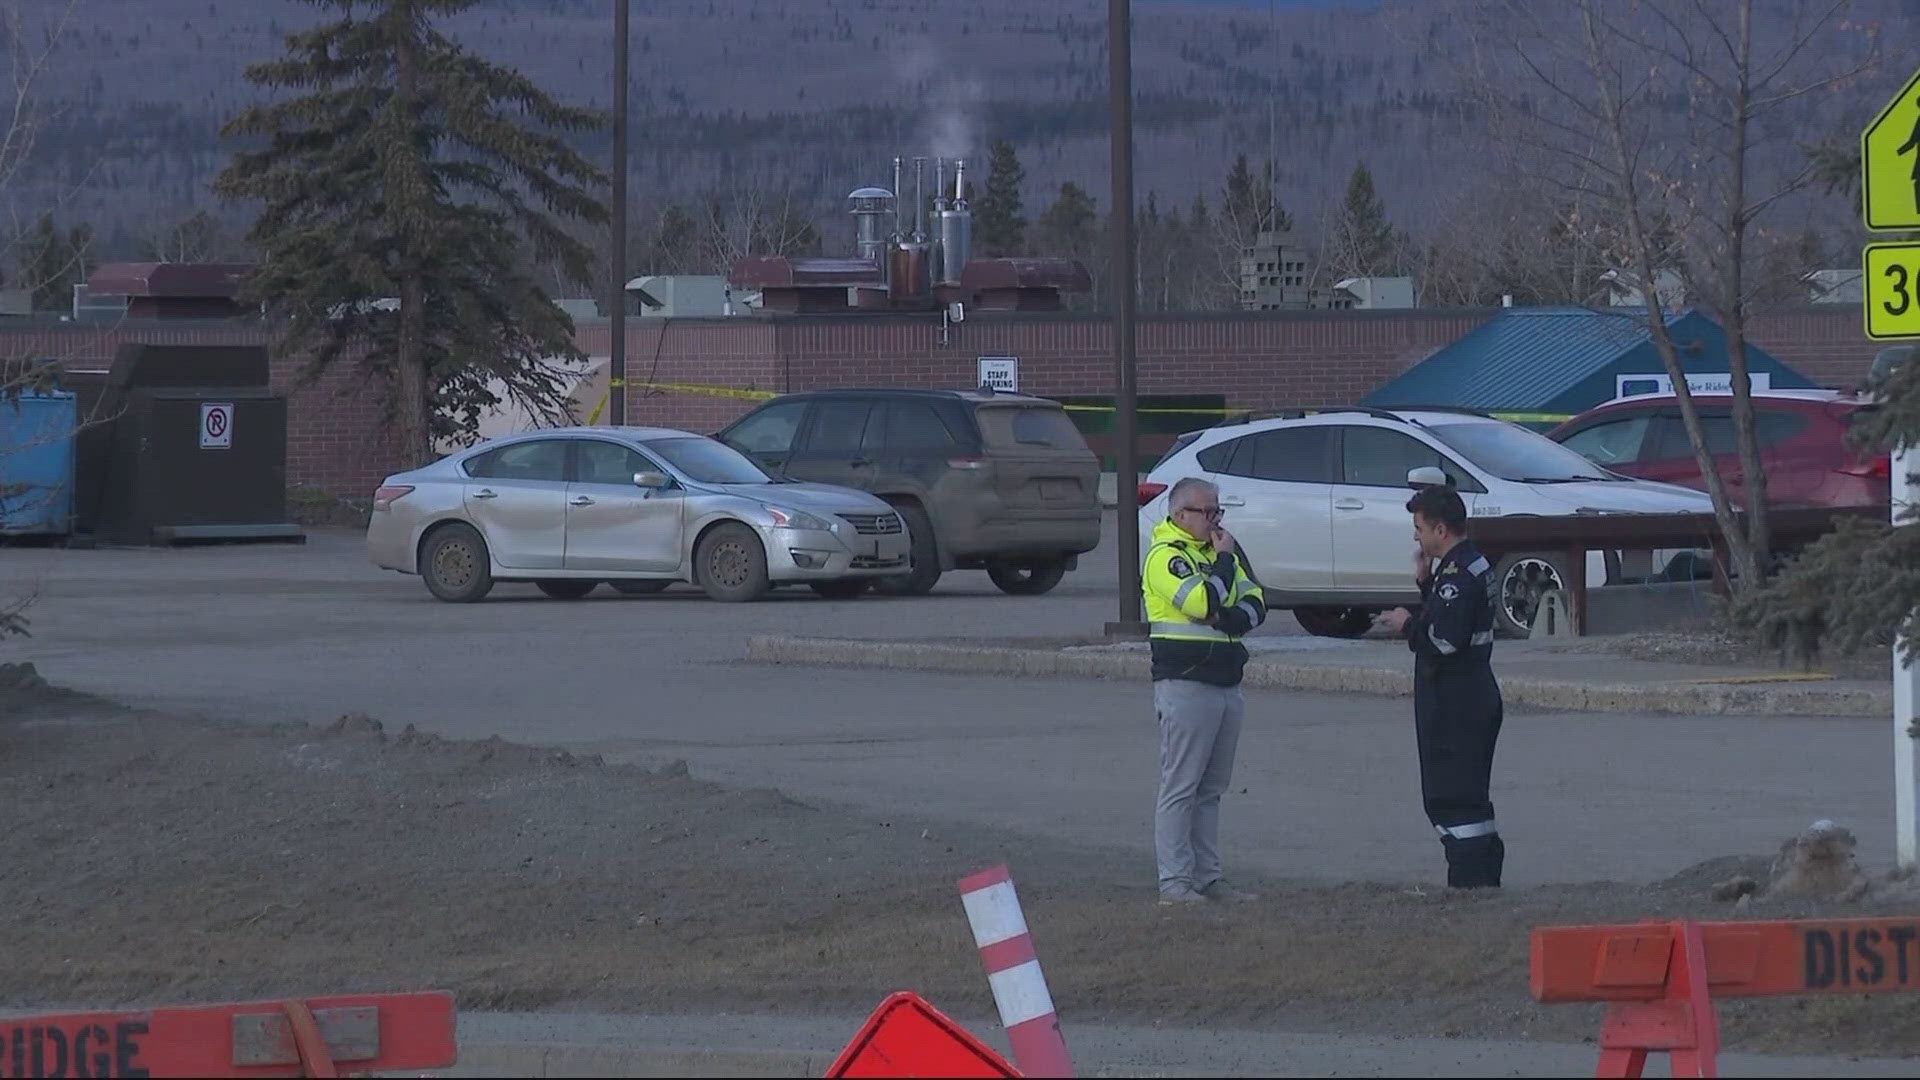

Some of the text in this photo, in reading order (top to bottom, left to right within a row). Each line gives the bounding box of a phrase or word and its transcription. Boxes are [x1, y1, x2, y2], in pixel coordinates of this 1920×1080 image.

[1883, 264, 1920, 316] 3
[983, 380, 1012, 388] PARKING
[988, 371, 1008, 379] STAFF
[1806, 927, 1920, 987] DIST
[0, 1022, 150, 1078] IDGE
